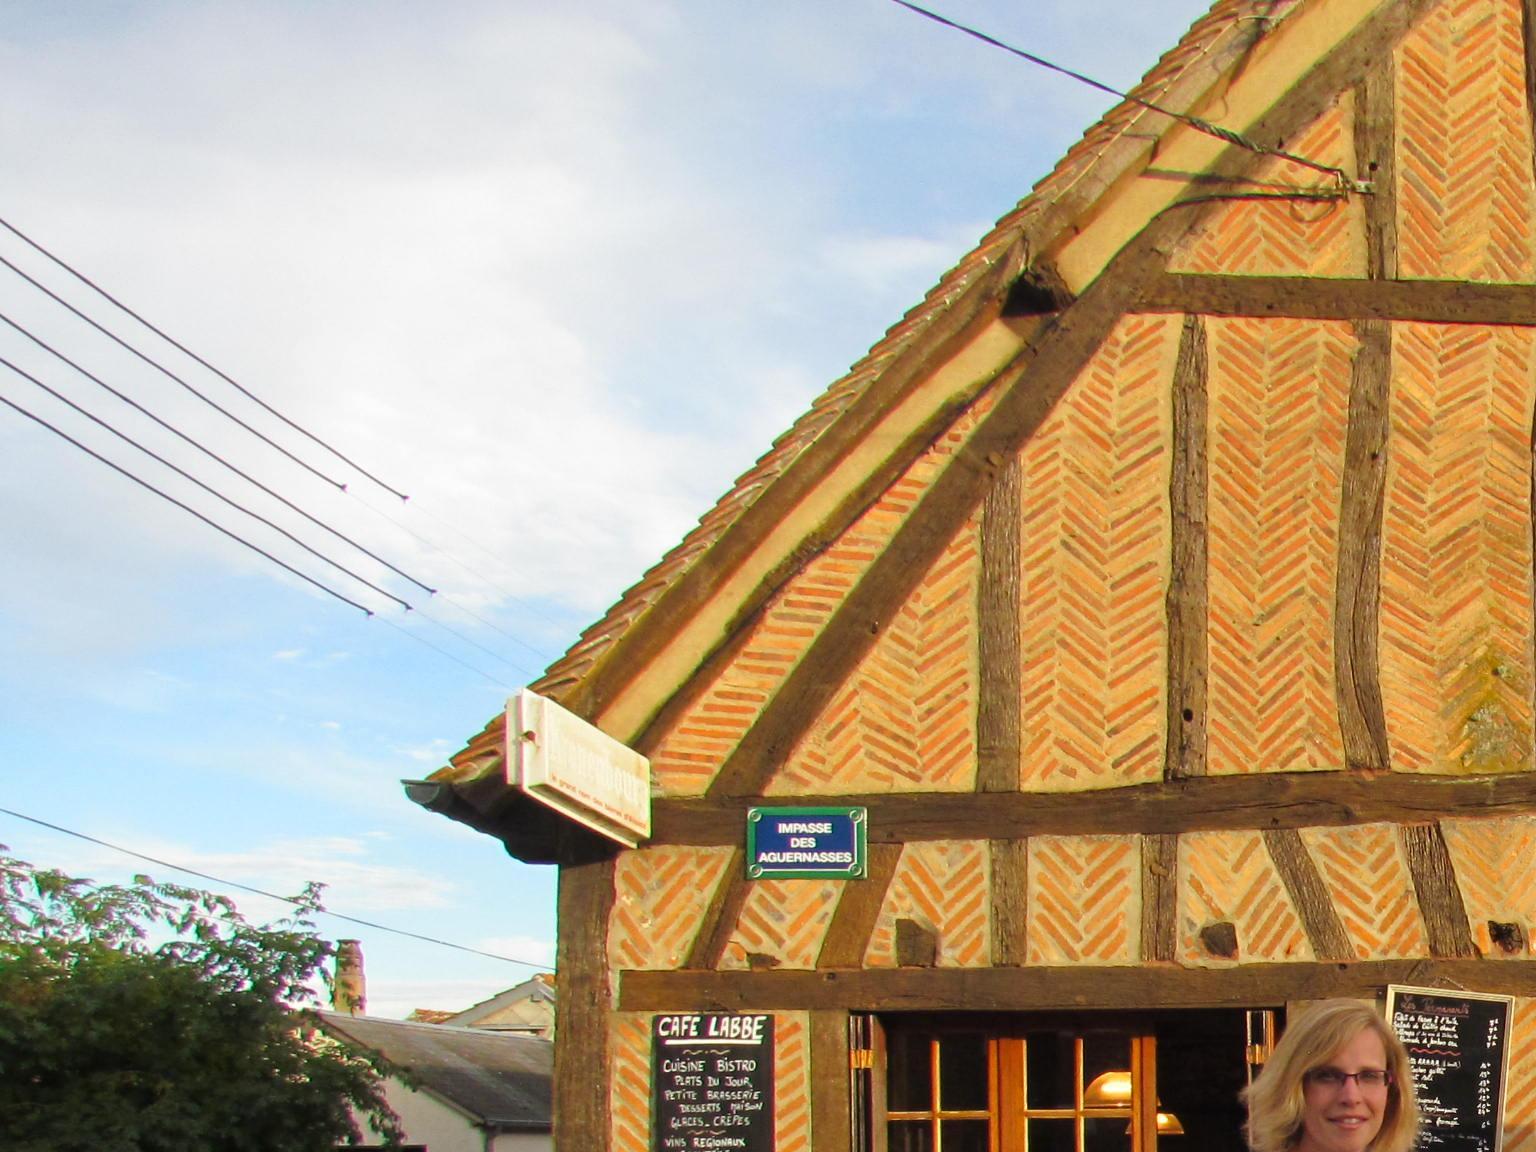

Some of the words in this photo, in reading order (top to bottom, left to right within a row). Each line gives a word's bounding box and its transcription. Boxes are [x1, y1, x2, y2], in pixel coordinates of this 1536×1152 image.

[777, 822, 832, 834] IMPASSE
[790, 837, 816, 848] DES
[758, 852, 853, 863] AGUERNASSES
[658, 1015, 701, 1036] CAFE
[708, 1016, 767, 1040] LABBE
[674, 1075, 703, 1086] PLATS
[707, 1076, 720, 1086] DU
[679, 1103, 721, 1113] DESSERTS
